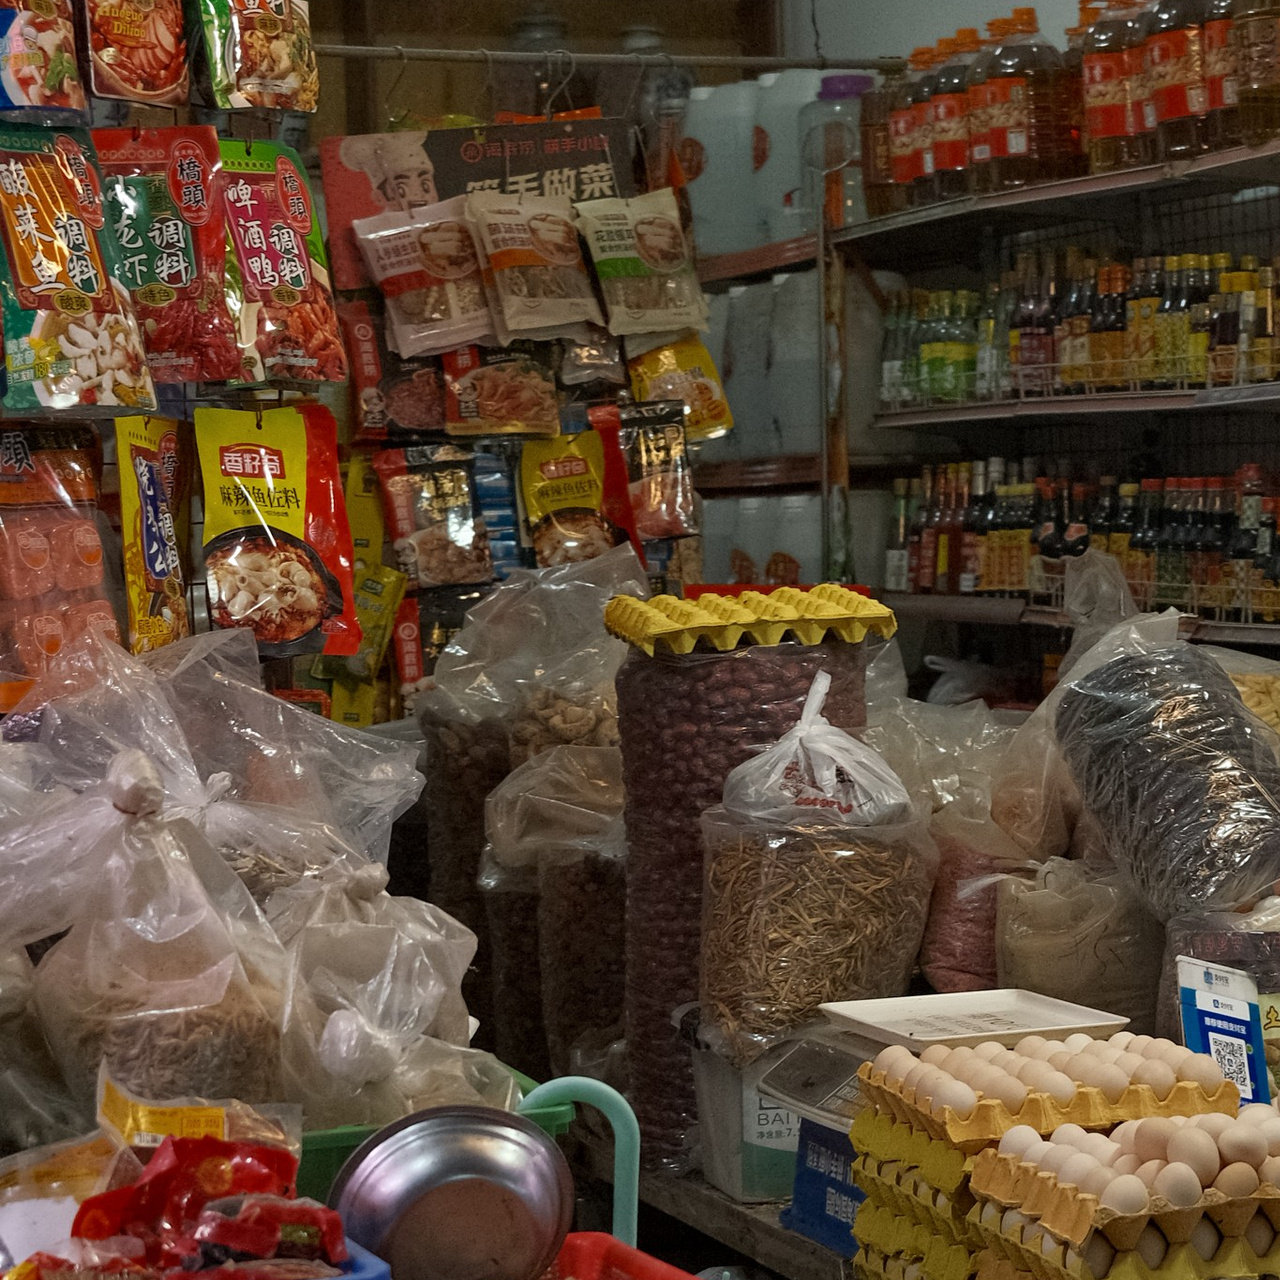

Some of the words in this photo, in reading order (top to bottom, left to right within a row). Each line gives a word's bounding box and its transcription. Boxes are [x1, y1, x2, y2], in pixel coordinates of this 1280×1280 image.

[177, 158, 207, 210] 橋頭
[281, 171, 309, 220] 橋頭
[56, 219, 99, 291] 调料
[148, 220, 190, 287] 调料
[227, 178, 279, 286] 啤酒鸭
[269, 228, 306, 288] 调料
[59, 294, 90, 311] 酸爽
